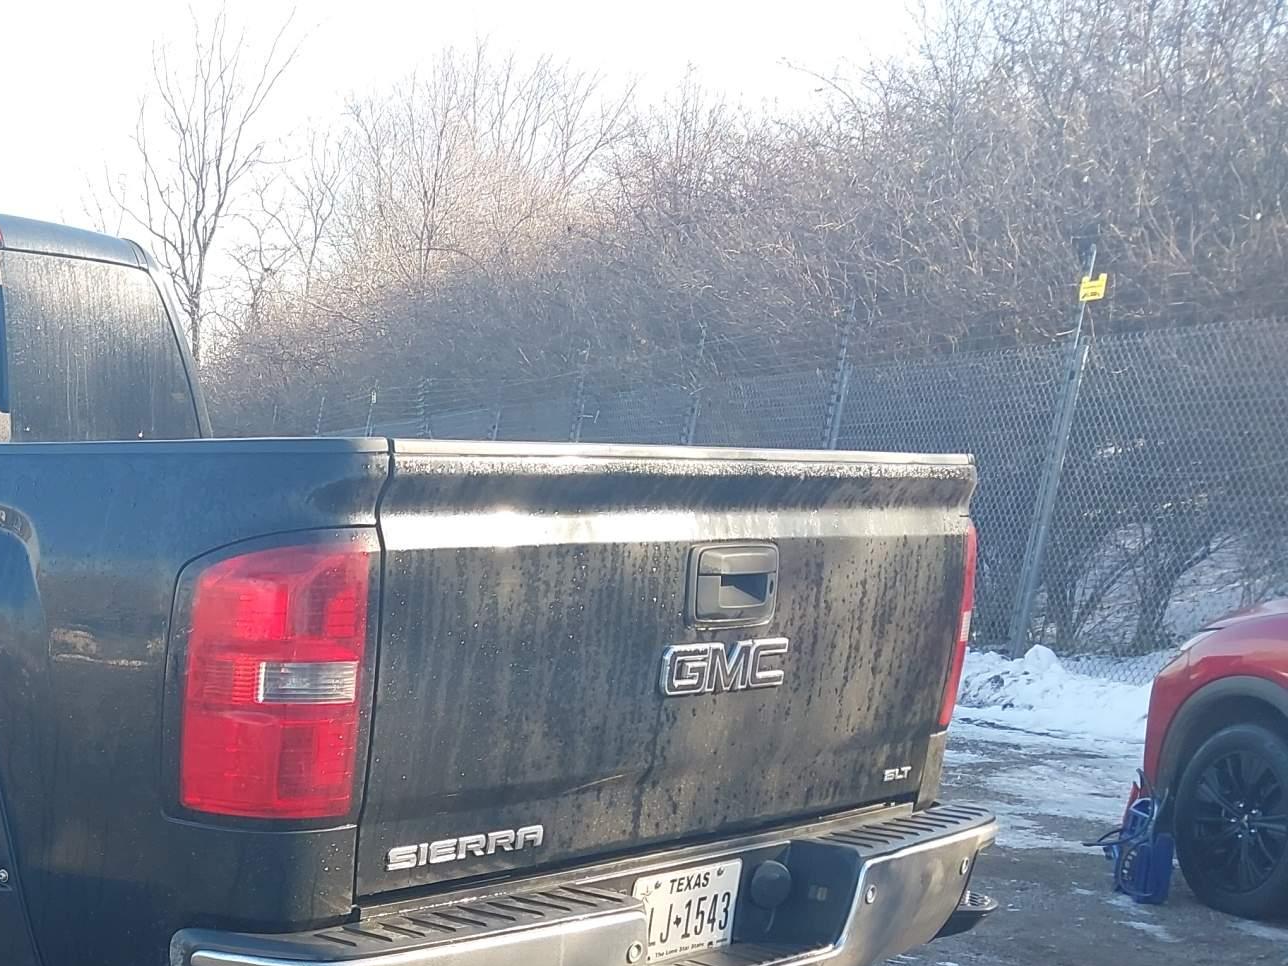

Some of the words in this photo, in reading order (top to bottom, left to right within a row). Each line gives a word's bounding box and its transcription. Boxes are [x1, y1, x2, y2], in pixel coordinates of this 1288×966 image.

[662, 637, 789, 696] GMC
[883, 766, 912, 782] SLT
[386, 824, 544, 871] SIERRA
[669, 871, 711, 895] TEXAS
